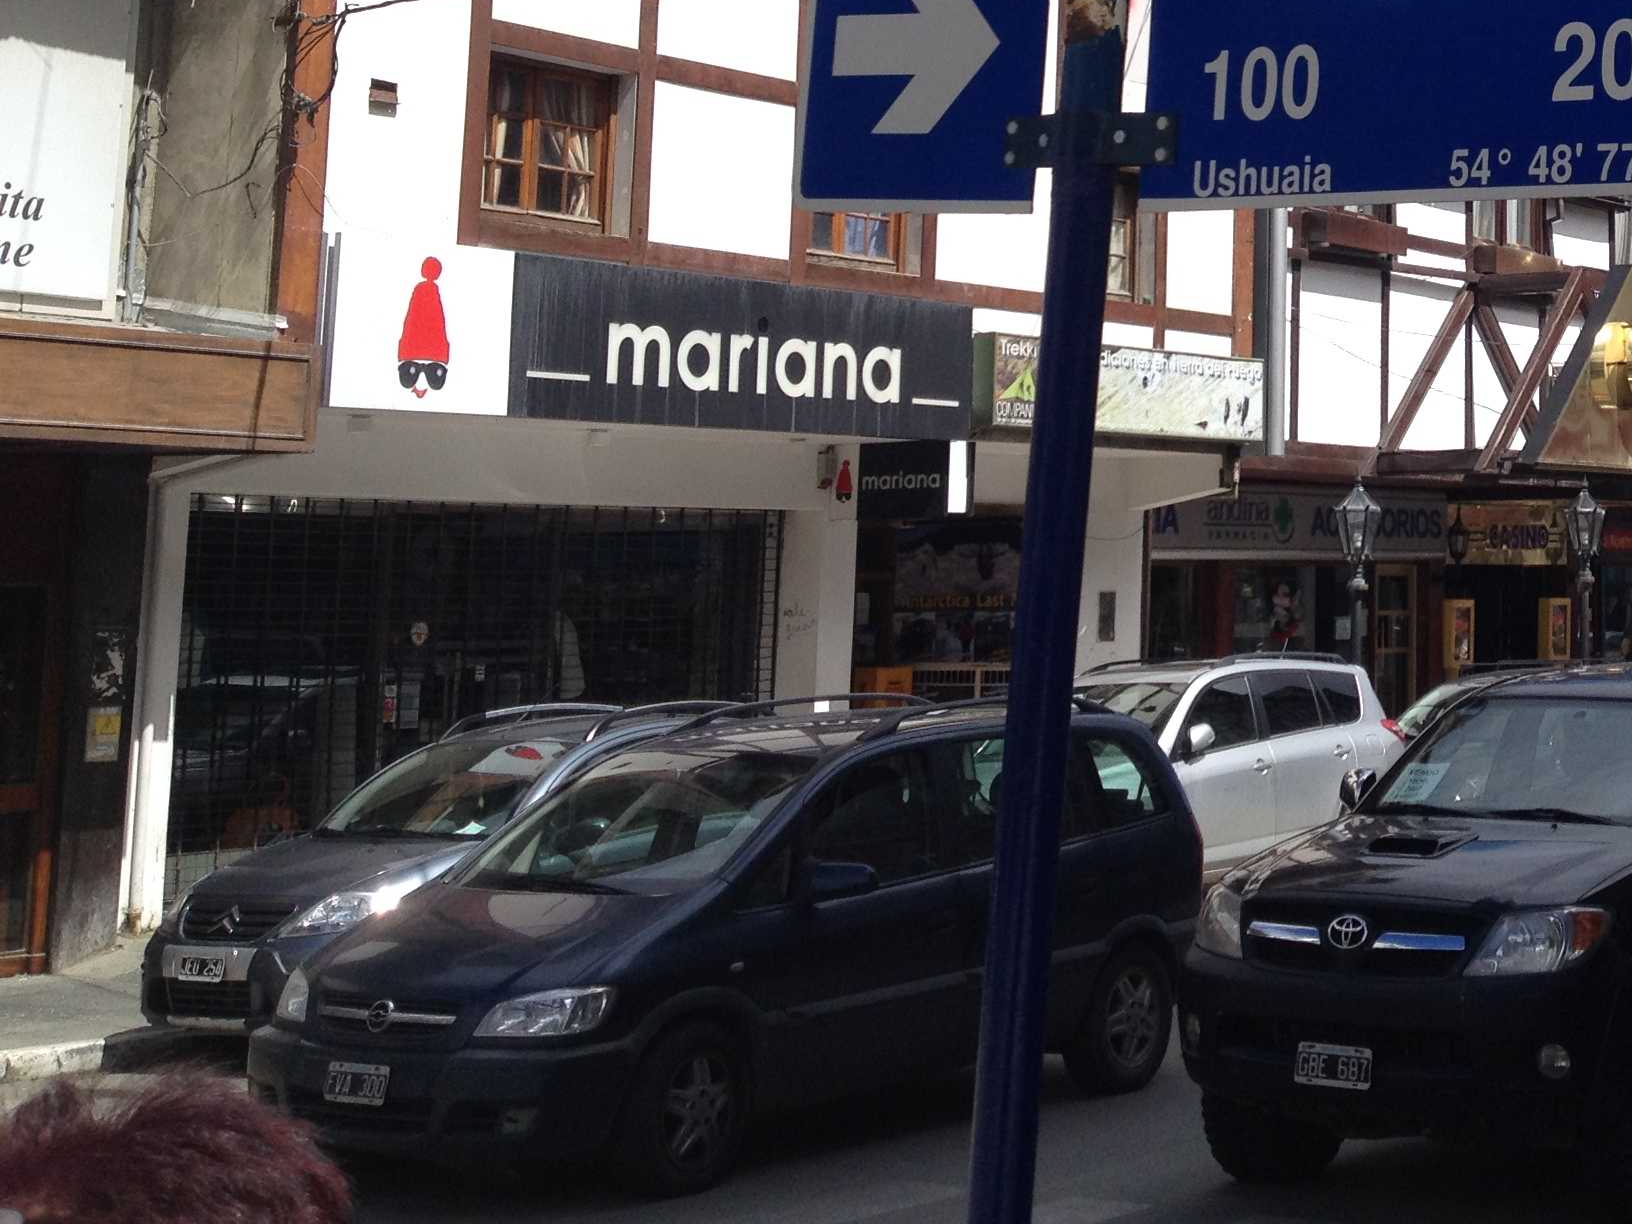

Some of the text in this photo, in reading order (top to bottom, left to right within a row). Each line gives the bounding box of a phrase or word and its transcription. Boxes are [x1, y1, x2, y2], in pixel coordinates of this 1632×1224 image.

[1204, 43, 1320, 121] 100
[1193, 155, 1332, 197] Ushuaia
[1448, 147, 1512, 188] 54°
[1528, 142, 1584, 184] 48'
[606, 321, 901, 405] mariana
[996, 399, 1036, 419] COMPAN
[861, 469, 942, 491] mariana
[1206, 498, 1270, 521] andina
[1298, 1051, 1368, 1082] GBE 687
[358, 1074, 386, 1097] 300
